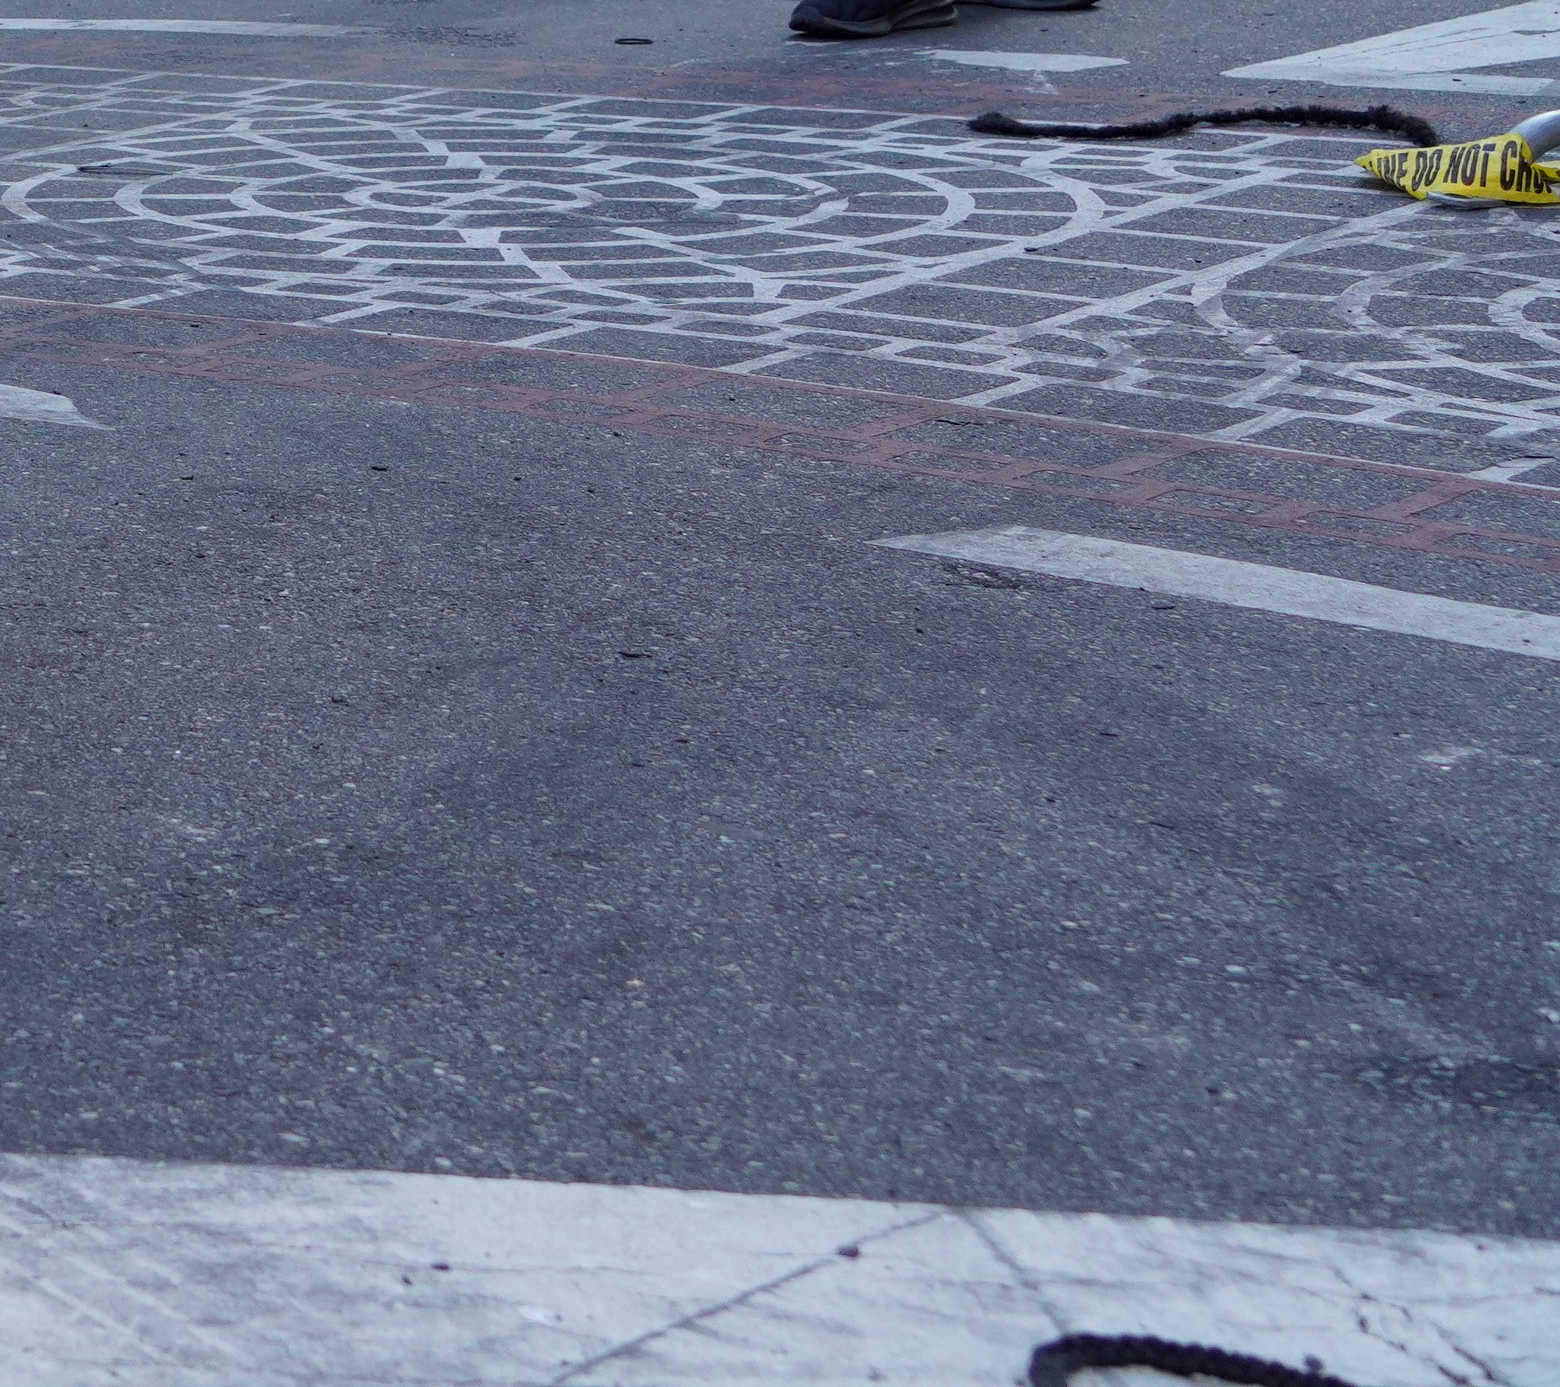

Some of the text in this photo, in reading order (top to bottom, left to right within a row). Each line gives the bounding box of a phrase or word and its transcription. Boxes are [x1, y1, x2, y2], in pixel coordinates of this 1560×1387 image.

[1373, 152, 1409, 191] INE
[1411, 148, 1444, 192] DO
[1444, 143, 1496, 188] NOT
